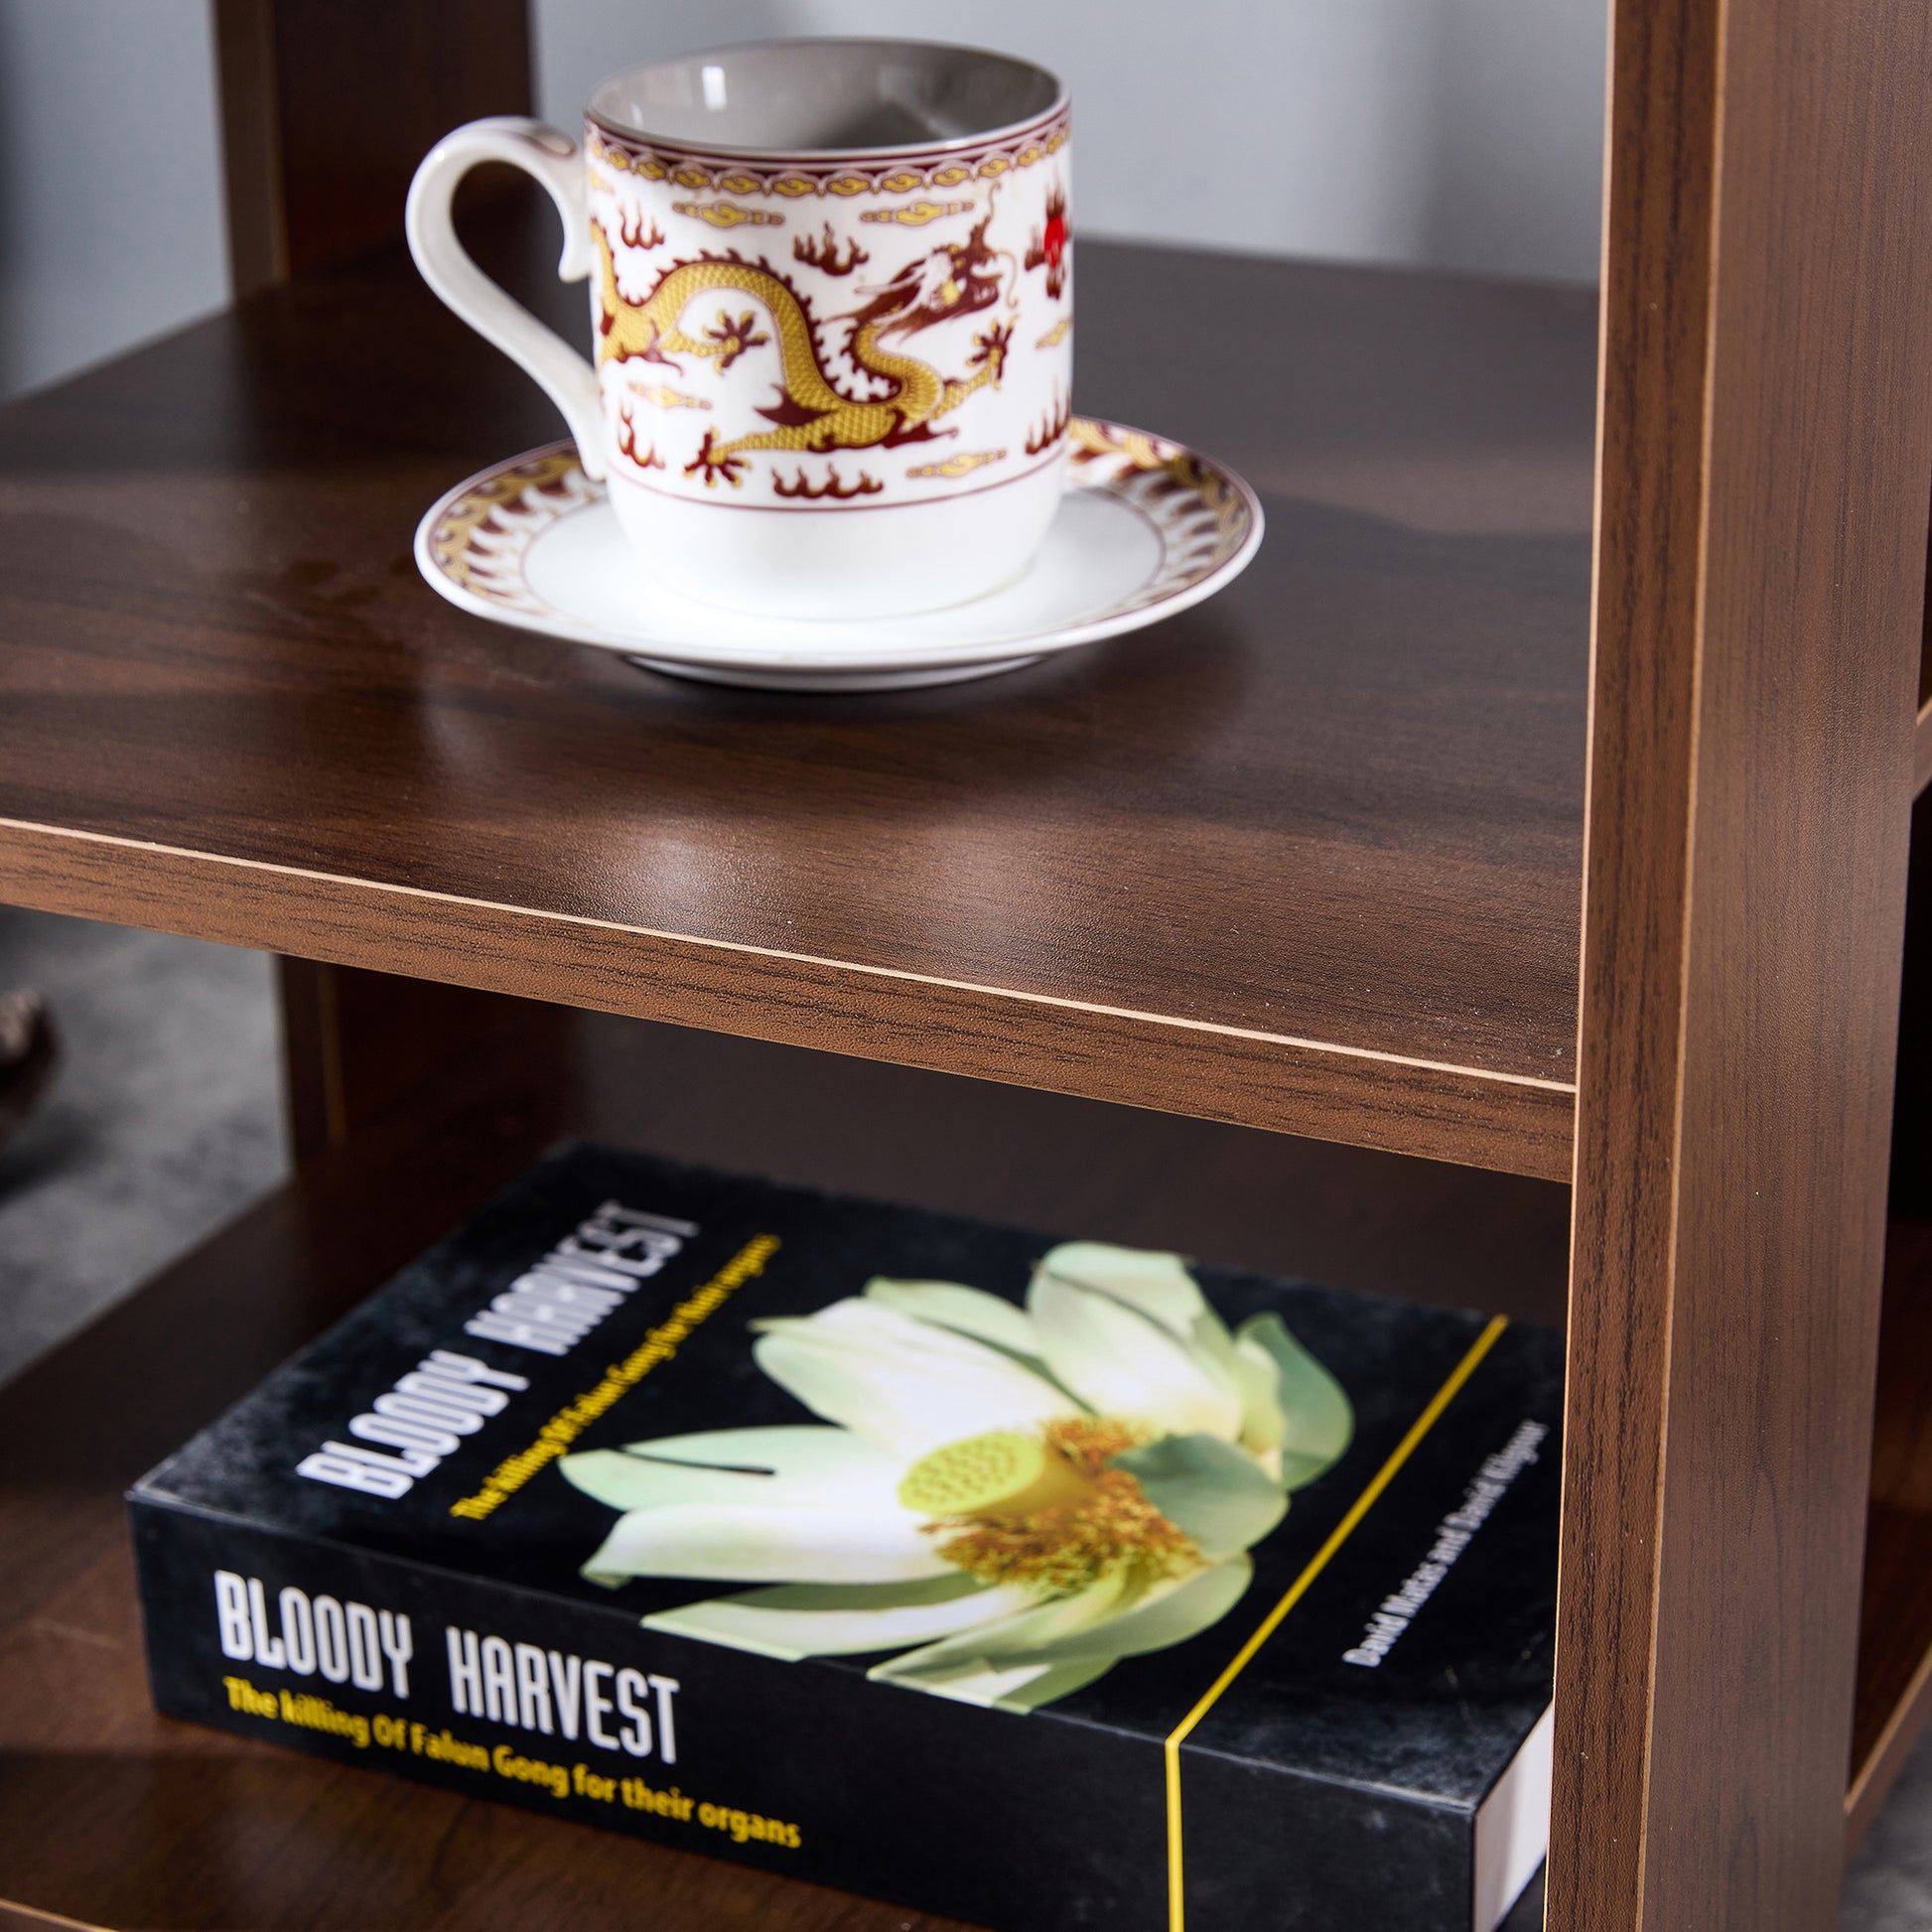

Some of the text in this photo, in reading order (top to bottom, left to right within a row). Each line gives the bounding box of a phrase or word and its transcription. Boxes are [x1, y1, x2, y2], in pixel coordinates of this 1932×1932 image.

[706, 1232, 782, 1291] organs
[668, 1284, 731, 1325] their
[295, 1199, 700, 1500] BLOODY HARVEST
[645, 1318, 693, 1349] for
[605, 1339, 677, 1386] Gong
[558, 1377, 630, 1427] Falun
[449, 1487, 508, 1521] The
[1341, 1419, 1551, 1668] David Matas and David Kilgour
[213, 1569, 680, 1765] BLOODY HARVEST
[222, 1675, 801, 1848] The killing Of Falun Gong for their organs
